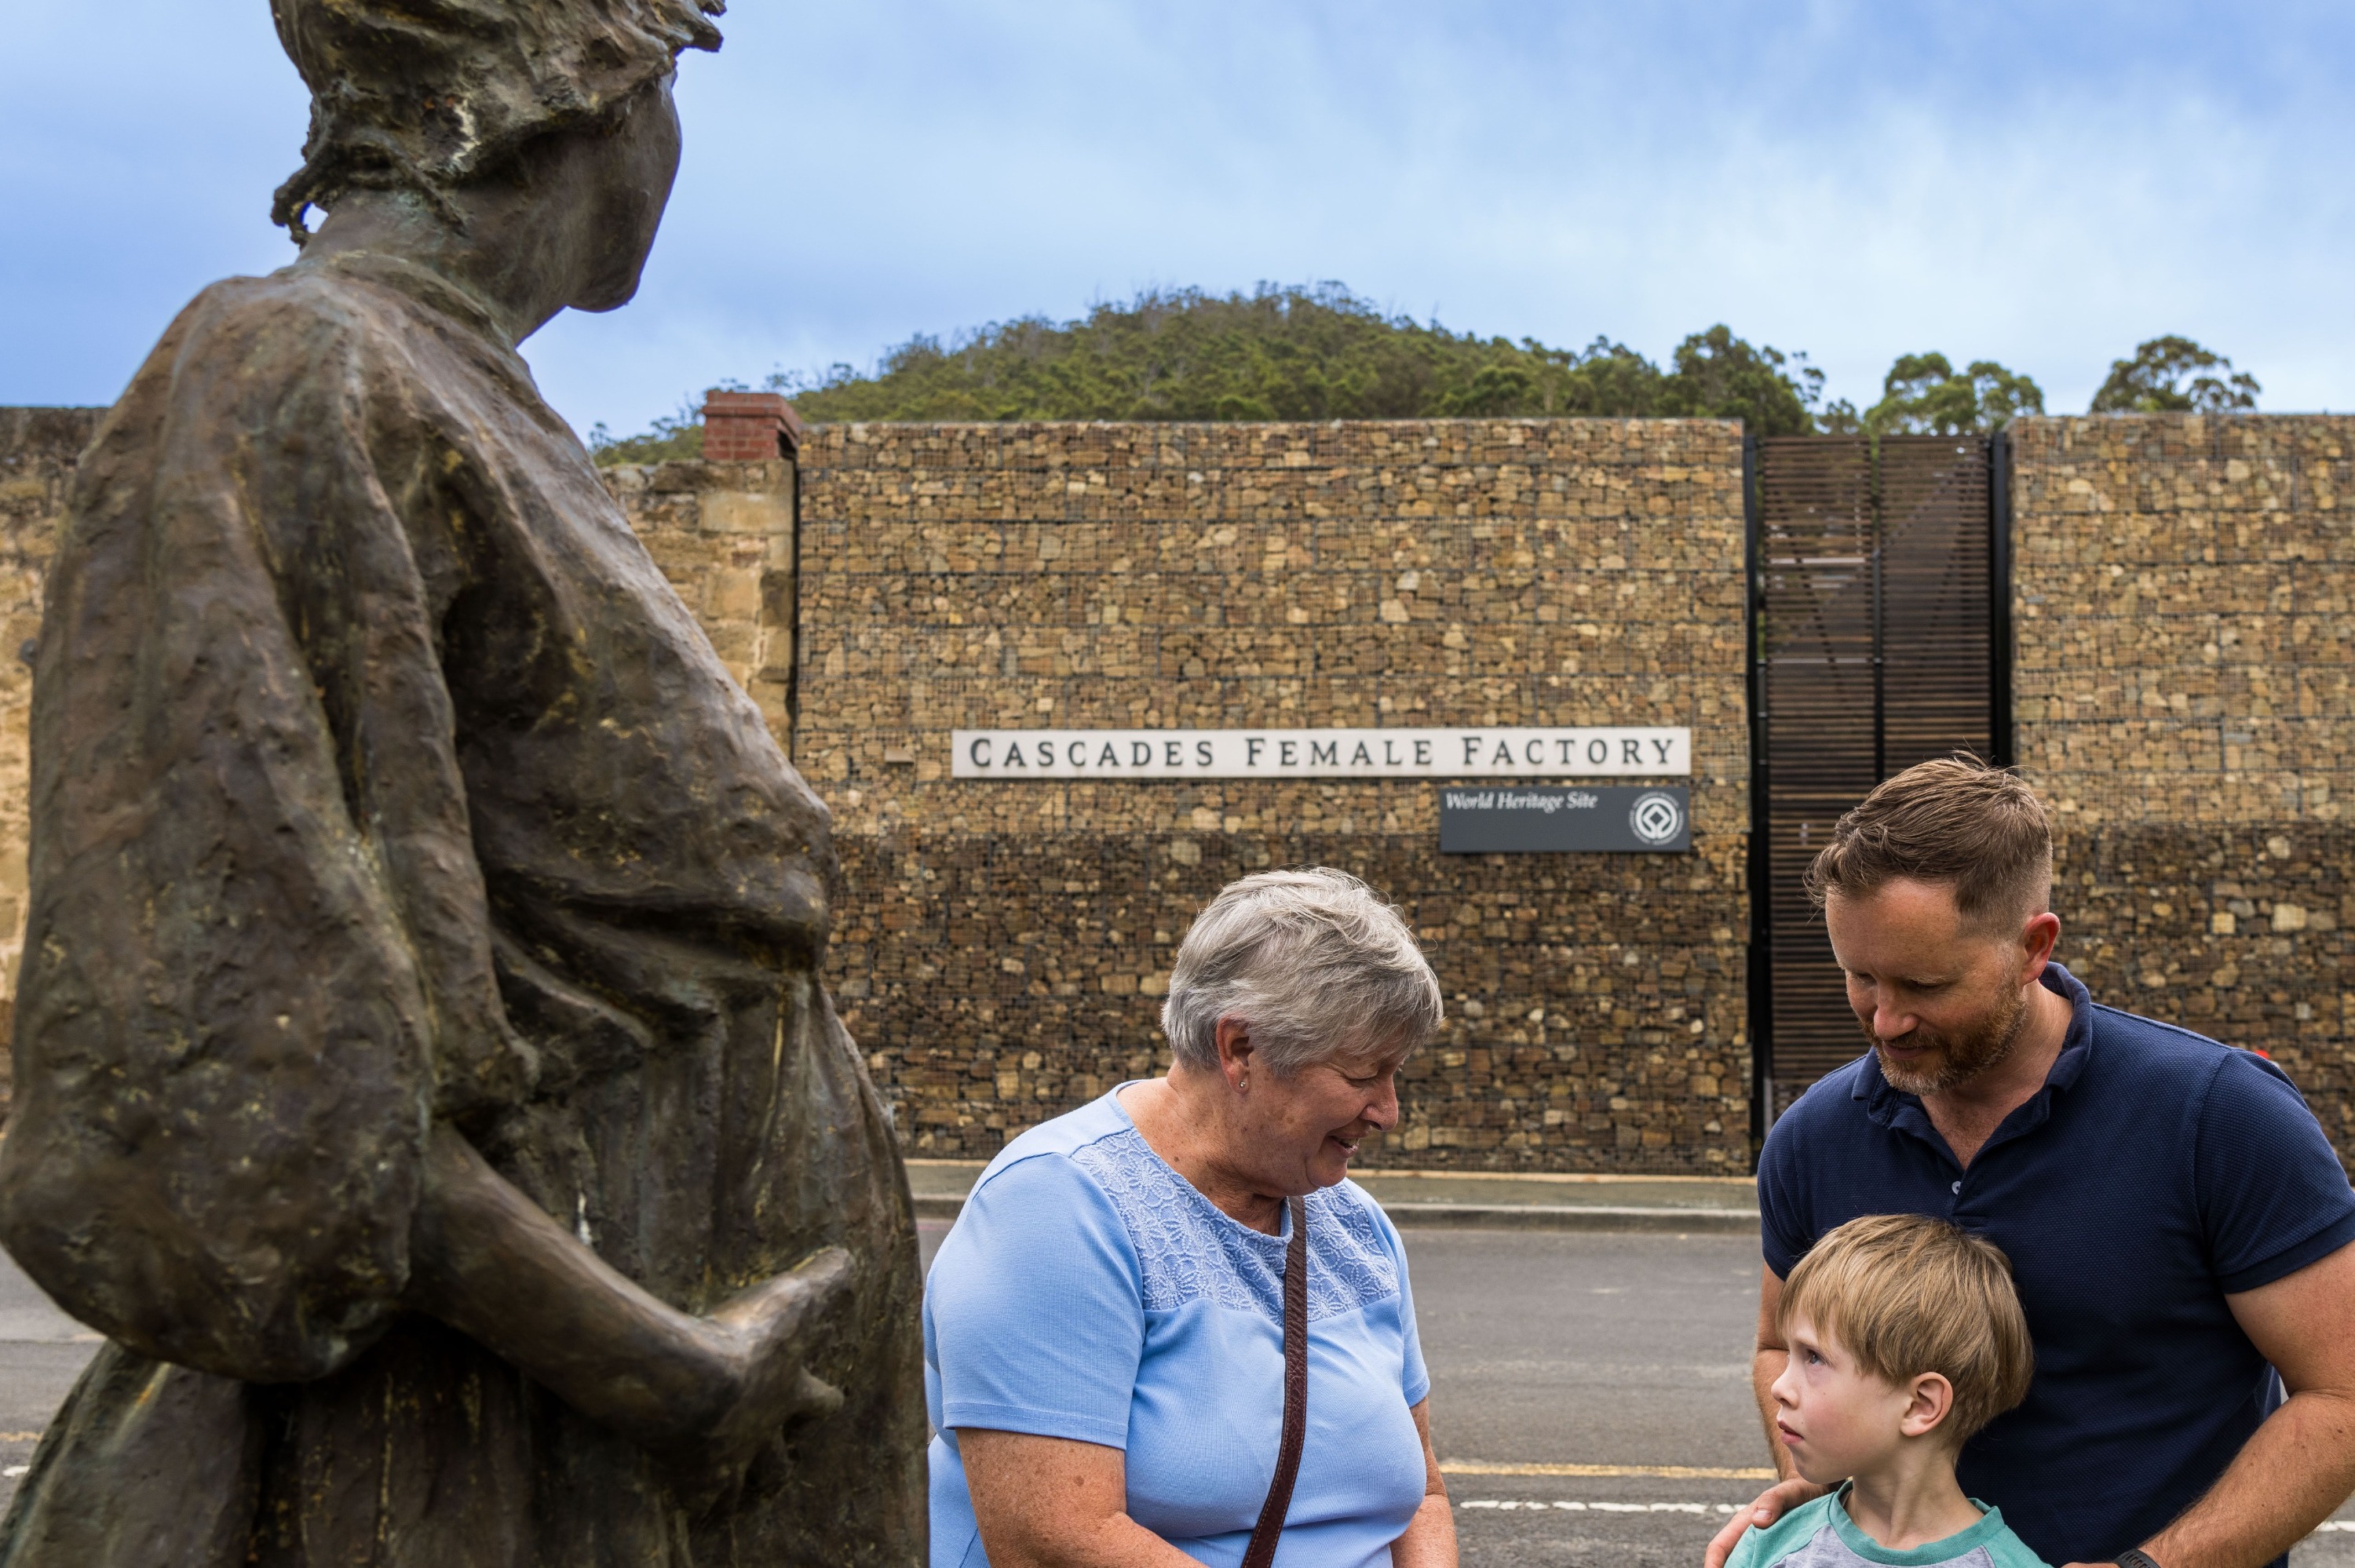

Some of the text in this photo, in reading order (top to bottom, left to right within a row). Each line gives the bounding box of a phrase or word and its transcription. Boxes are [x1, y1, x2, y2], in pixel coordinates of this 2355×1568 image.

[970, 736, 1674, 768] CASCADES FEMALE FACTORY
[1445, 792, 1598, 814] World Heritage Site
